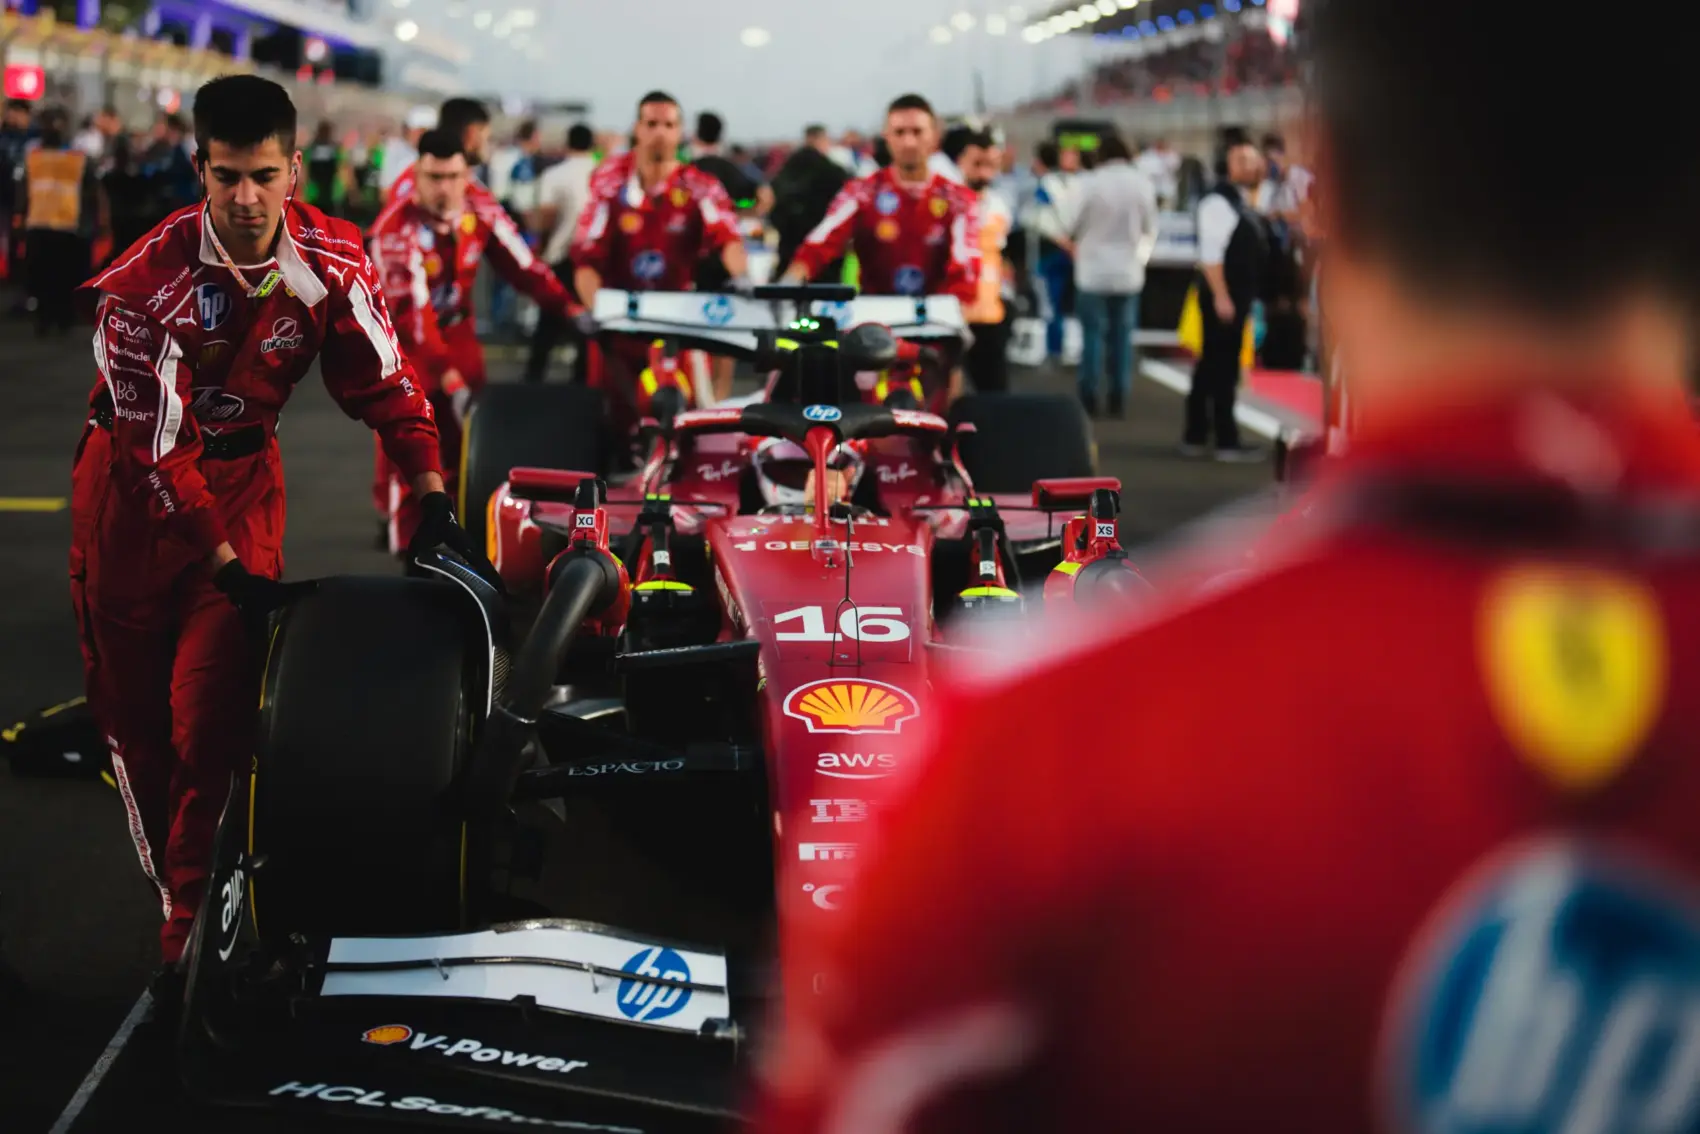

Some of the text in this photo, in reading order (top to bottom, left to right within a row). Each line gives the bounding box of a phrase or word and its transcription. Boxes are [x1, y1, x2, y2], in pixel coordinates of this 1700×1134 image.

[168, 265, 191, 289] TECHNO
[195, 283, 227, 330] hp
[261, 333, 304, 353] UniCredit
[118, 406, 150, 422] bipar
[808, 404, 837, 421] hp
[764, 540, 926, 557] GEESYS
[773, 604, 911, 643] 16
[817, 752, 898, 768] aws
[808, 799, 869, 824] IB
[620, 945, 688, 1022] hp
[1445, 836, 1700, 1134] hp
[409, 1031, 589, 1074] V-Power
[268, 1080, 645, 1133] HCLSoft
